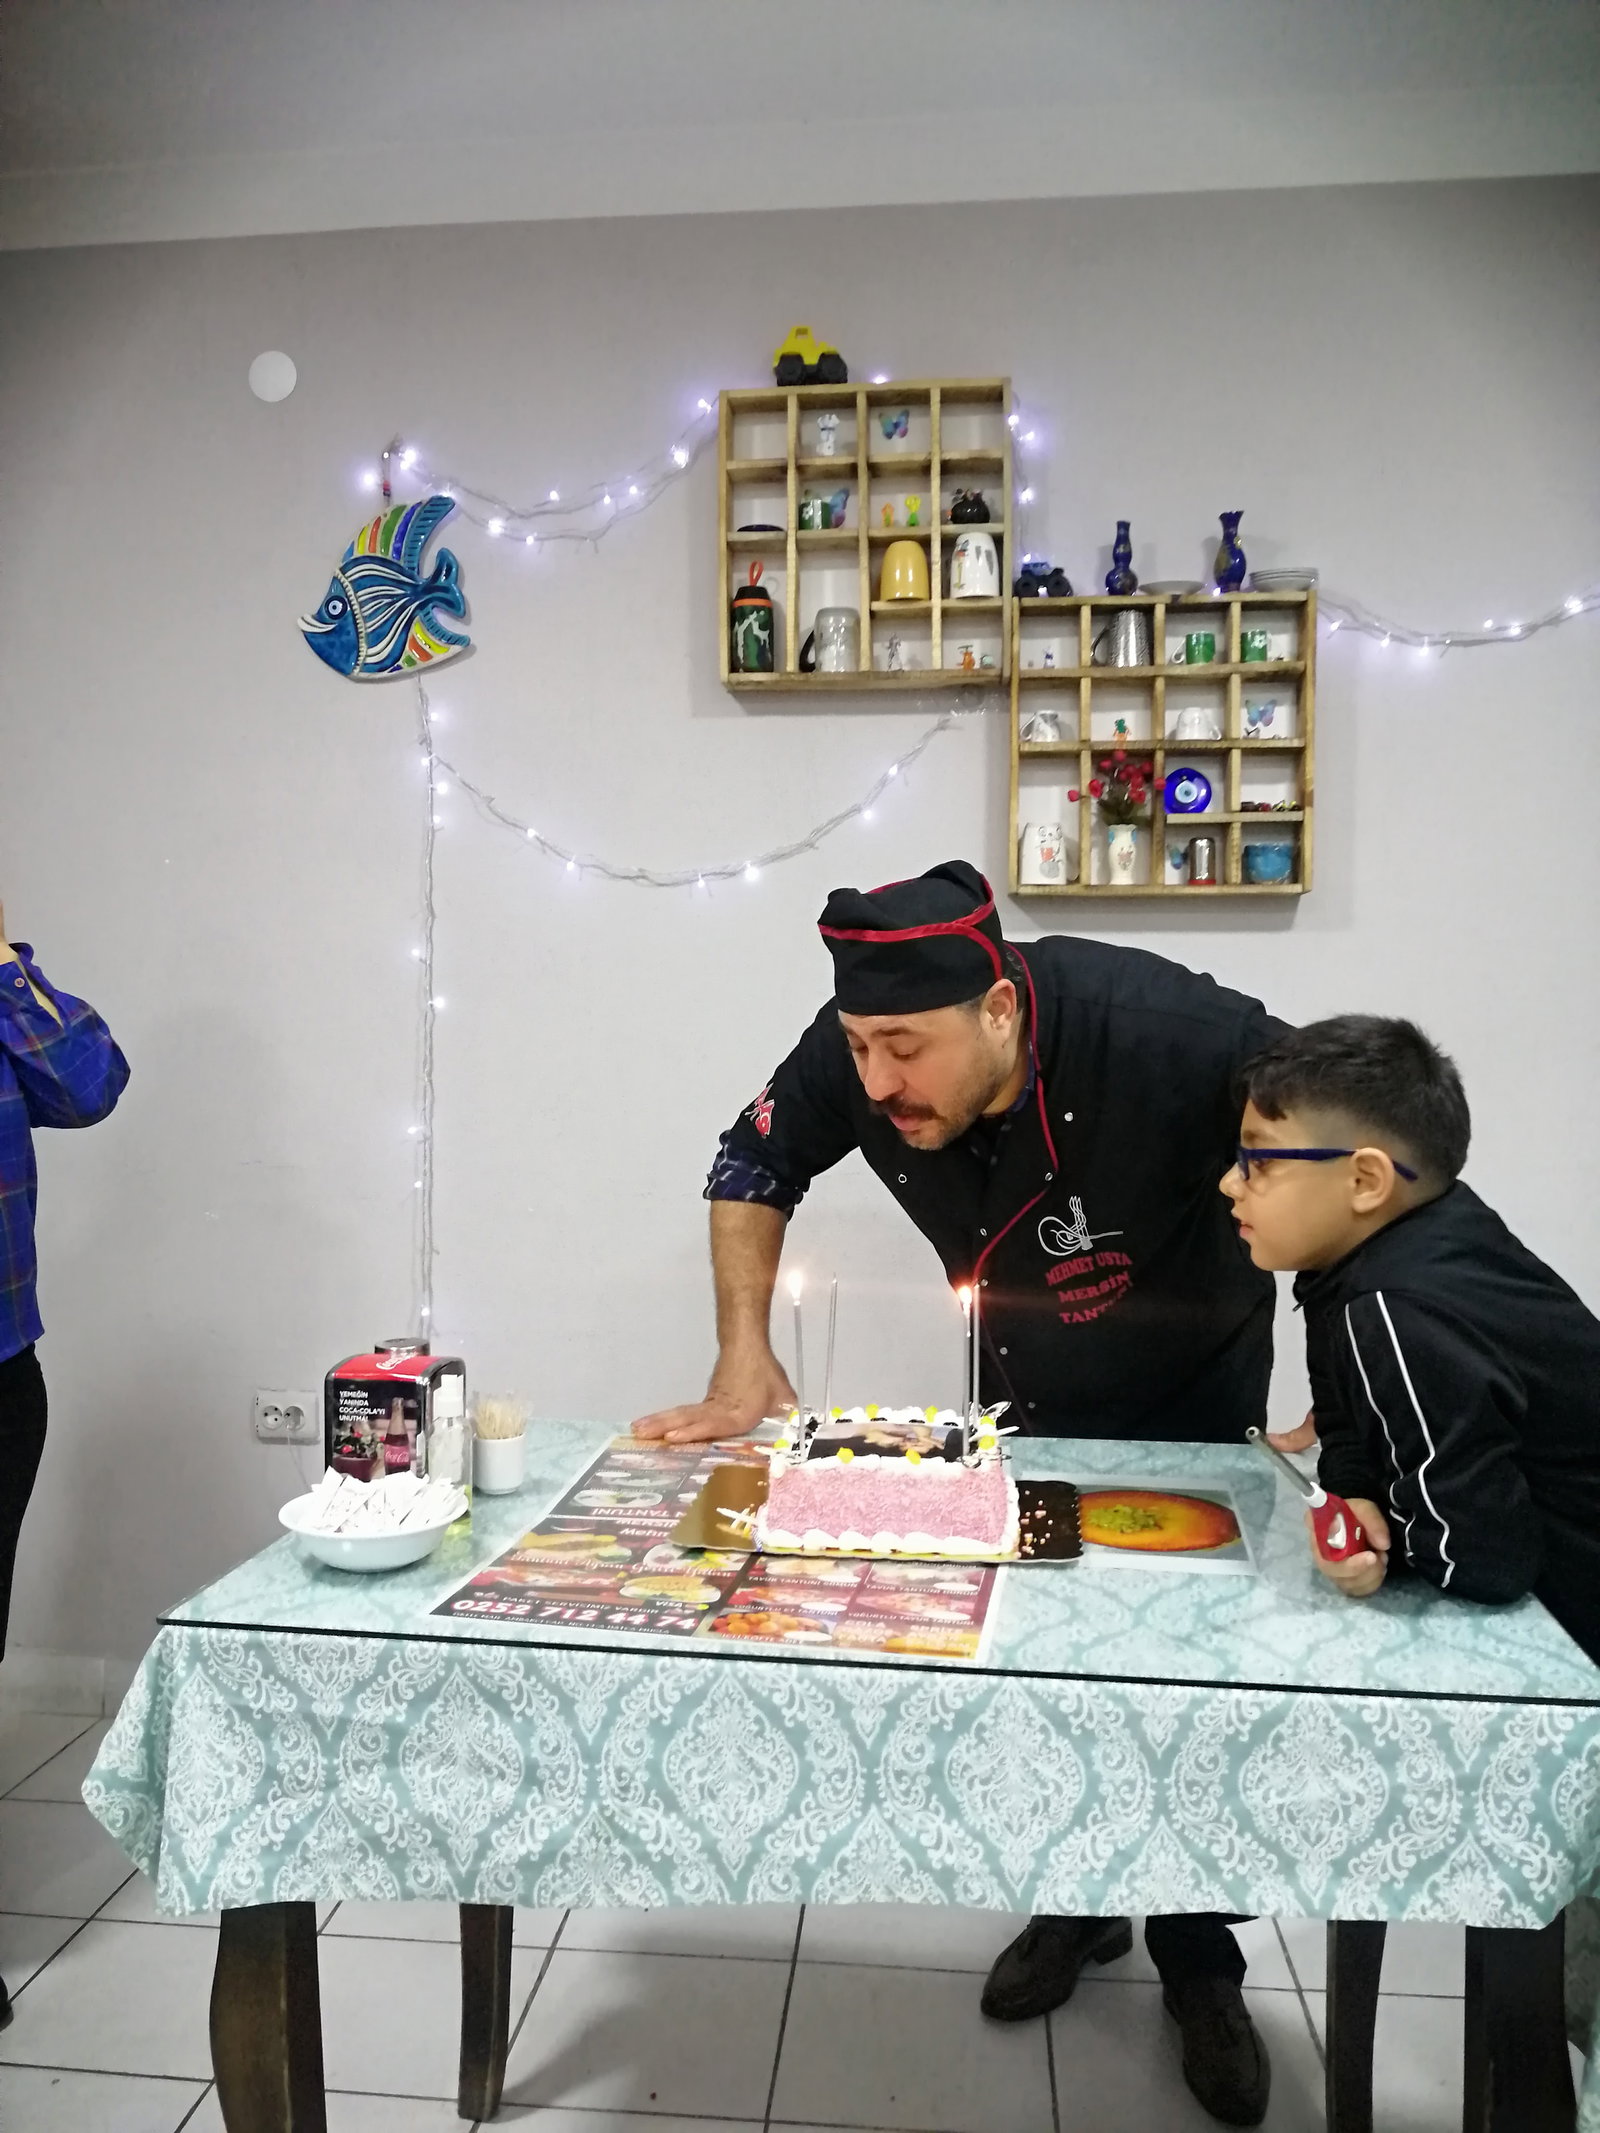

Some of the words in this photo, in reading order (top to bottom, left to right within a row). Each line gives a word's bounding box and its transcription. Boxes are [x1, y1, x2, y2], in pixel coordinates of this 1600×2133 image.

[1045, 1255, 1095, 1287] MEHMET
[1095, 1251, 1133, 1267] USTA
[1057, 1271, 1130, 1303] MERSİN
[1059, 1280, 1133, 1324] TANT
[339, 1390, 369, 1399] YEMEĞİN
[339, 1399, 369, 1407] YANINDA
[339, 1407, 386, 1415] COCA-COLA'YI
[452, 1600, 532, 1616] 0252
[538, 1606, 599, 1622] 712
[606, 1611, 648, 1626] 44
[654, 1615, 697, 1631] 74
